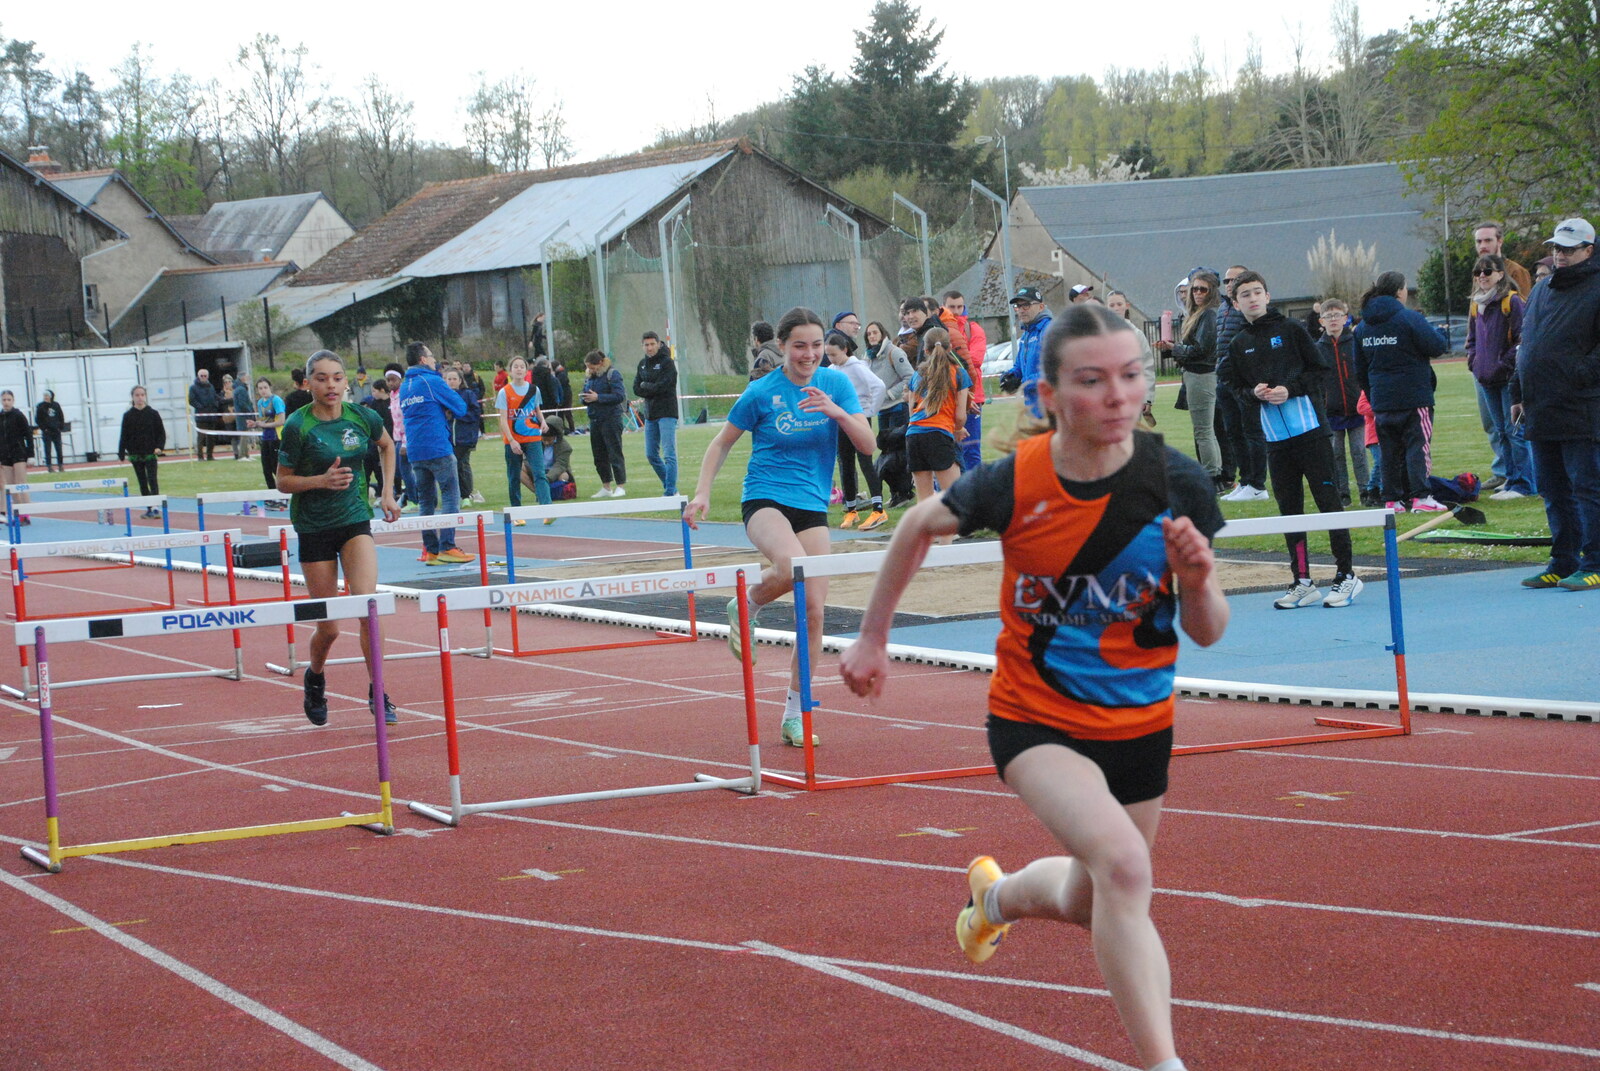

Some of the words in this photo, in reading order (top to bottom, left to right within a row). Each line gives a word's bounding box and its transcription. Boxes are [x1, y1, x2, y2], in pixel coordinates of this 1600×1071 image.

[54, 482, 81, 490] DIMA
[488, 586, 576, 606] DYNAMIC
[161, 608, 257, 631] POLANIK
